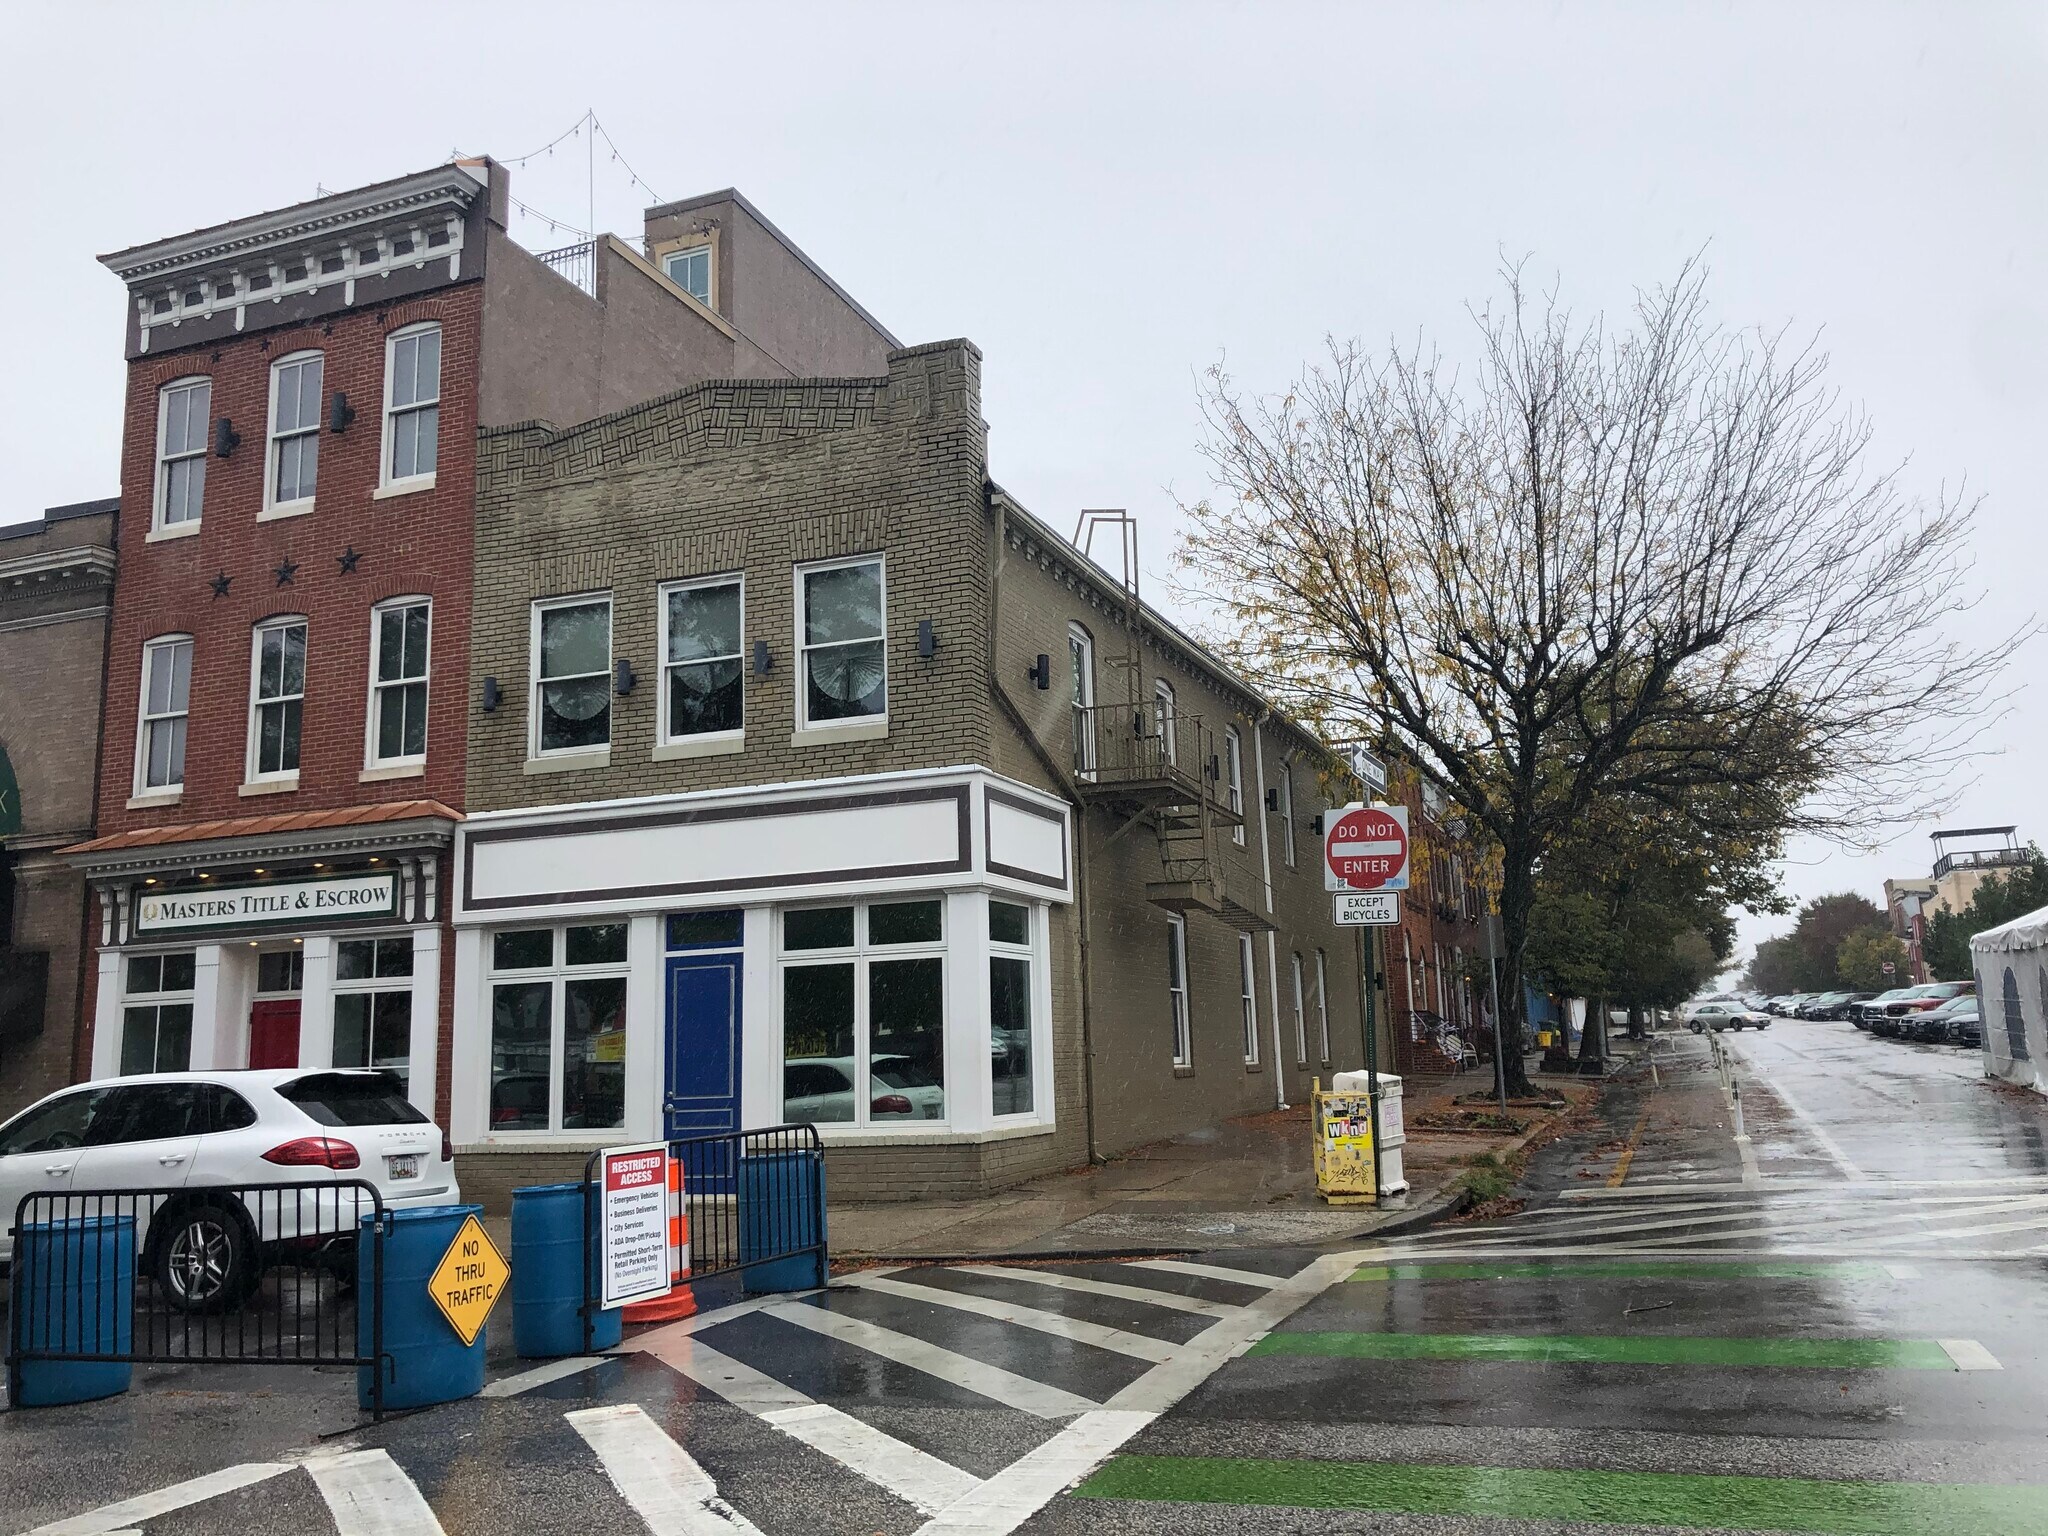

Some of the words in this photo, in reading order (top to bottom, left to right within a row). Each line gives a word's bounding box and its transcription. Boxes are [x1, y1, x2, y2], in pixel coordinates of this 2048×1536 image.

[1338, 826, 1358, 838] DO
[1366, 824, 1395, 837] NOT
[1344, 860, 1390, 873] ENTER
[159, 900, 236, 920] MASTERS
[241, 895, 290, 914] TITLE
[294, 891, 310, 909] &
[315, 886, 390, 908] ESCROW
[1348, 897, 1385, 908] EXCEPT
[1343, 909, 1390, 920] BICYCLES
[1328, 1119, 1367, 1137] Wknd
[612, 1157, 660, 1173] RESTRICTED
[620, 1170, 653, 1185] ACCESS
[614, 1194, 640, 1204] Emergency
[641, 1191, 659, 1200] Vehicles
[614, 1209, 635, 1218] Business
[636, 1205, 658, 1214] Deliveries
[614, 1224, 623, 1232] City
[625, 1221, 644, 1230] Services
[614, 1237, 624, 1246] ADA
[625, 1231, 661, 1244] Drop-Off/Pickup
[463, 1240, 479, 1257] NO
[614, 1248, 637, 1259] Permitted
[638, 1244, 663, 1255] Short-Term
[615, 1260, 628, 1269] Retail
[629, 1257, 647, 1266] Parking
[648, 1254, 658, 1262] Only
[642, 1264, 658, 1273] Parking)
[455, 1262, 486, 1282] THRU
[447, 1284, 493, 1308] TRAFFIC
